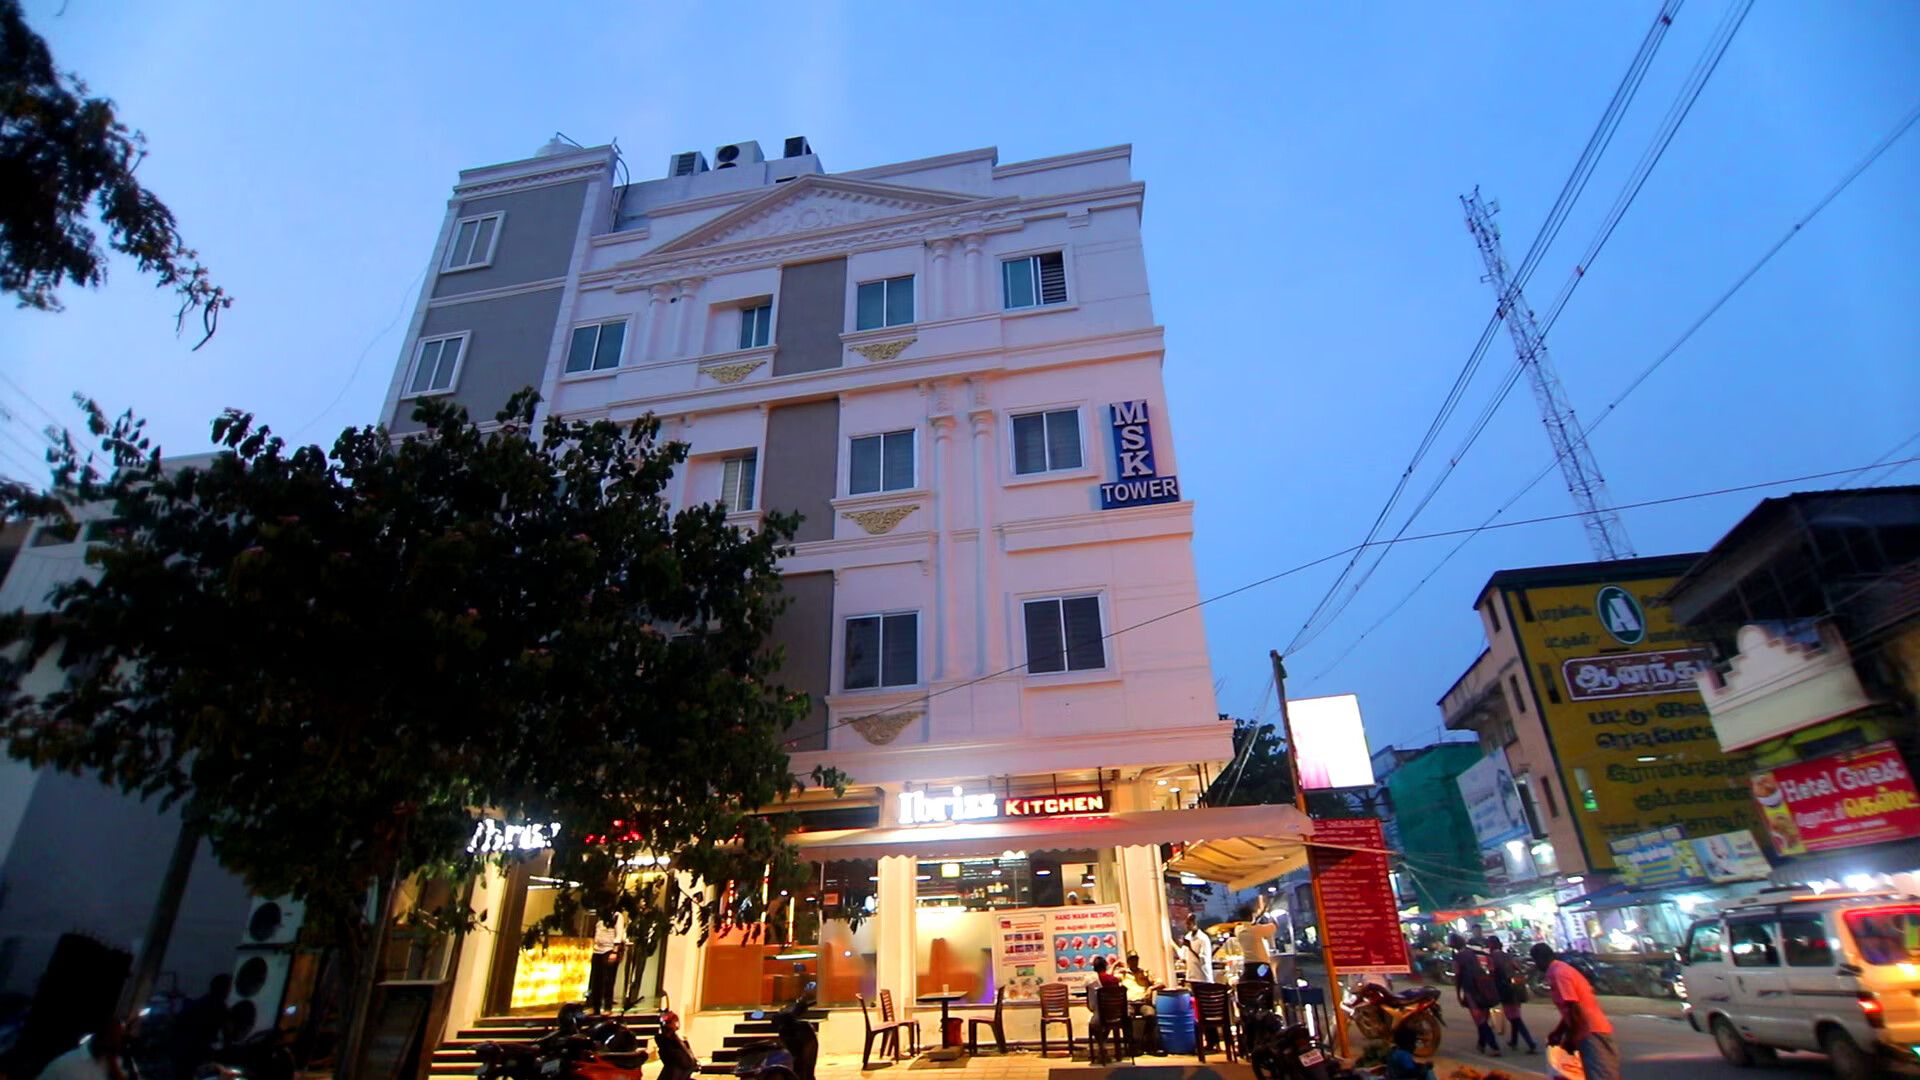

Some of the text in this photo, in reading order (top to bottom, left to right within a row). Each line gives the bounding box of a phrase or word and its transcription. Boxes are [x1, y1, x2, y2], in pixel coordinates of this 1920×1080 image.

[1102, 479, 1178, 502] TOWER
[1780, 770, 1839, 803] Hotel
[1004, 796, 1104, 816] KITCHEN
